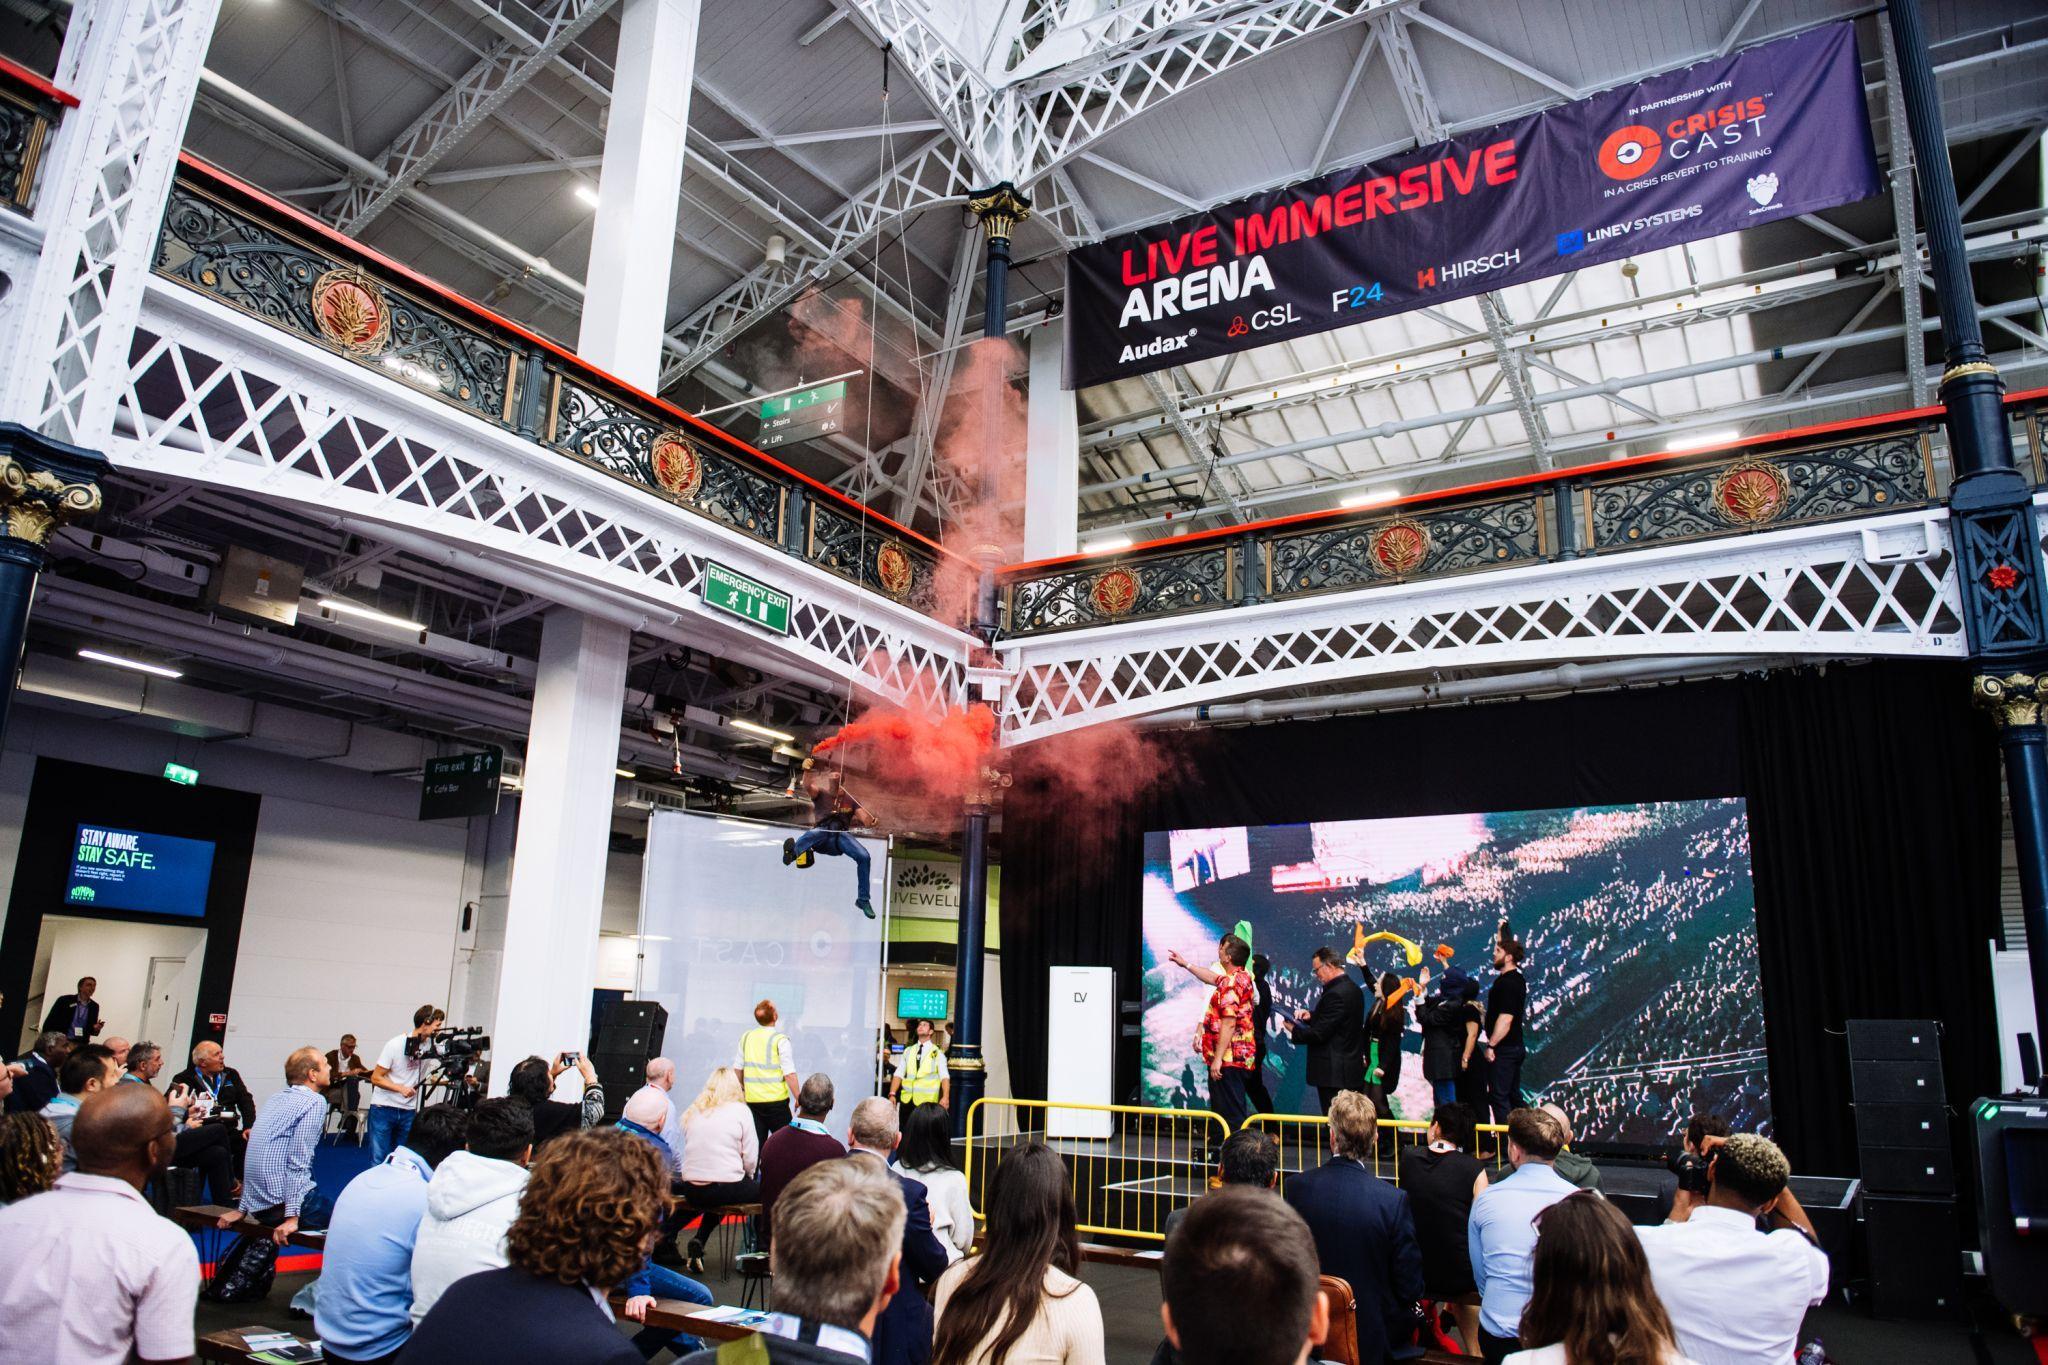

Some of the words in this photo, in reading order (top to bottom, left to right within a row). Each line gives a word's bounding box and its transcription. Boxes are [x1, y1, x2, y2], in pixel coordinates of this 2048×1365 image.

[1628, 107, 1639, 116] IN
[1641, 89, 1705, 112] PARTNERSHIP
[1706, 80, 1732, 94] WITH
[1669, 114, 1767, 160] CAST
[1604, 188, 1616, 198] IN
[1616, 186, 1625, 195] A
[1626, 177, 1659, 192] CRISIS
[1660, 165, 1702, 182] REVERT
[1703, 160, 1718, 171] TO
[1719, 147, 1772, 166] TRAINING
[1121, 225, 1218, 286] LIVE
[1233, 139, 1518, 257] IMMERSIVE
[1587, 222, 1633, 242] LINEV
[1634, 204, 1703, 230] SYSTEMS
[1441, 248, 1521, 282] HIRSCH
[1118, 254, 1276, 328] ARENA
[1332, 282, 1384, 313] F24
[1250, 305, 1302, 332] CSL
[772, 417, 791, 428] Stairs
[771, 435, 783, 444] Lift
[709, 567, 767, 600] EMERGENCY
[767, 592, 787, 609] EXIT
[434, 763, 449, 773] Fire
[451, 761, 466, 772] exit
[80, 828, 106, 846] STAY
[104, 832, 139, 851] AWARE.
[77, 845, 103, 863] STAY
[104, 848, 156, 870] SAFE.
[889, 891, 960, 908] IVEWELL
